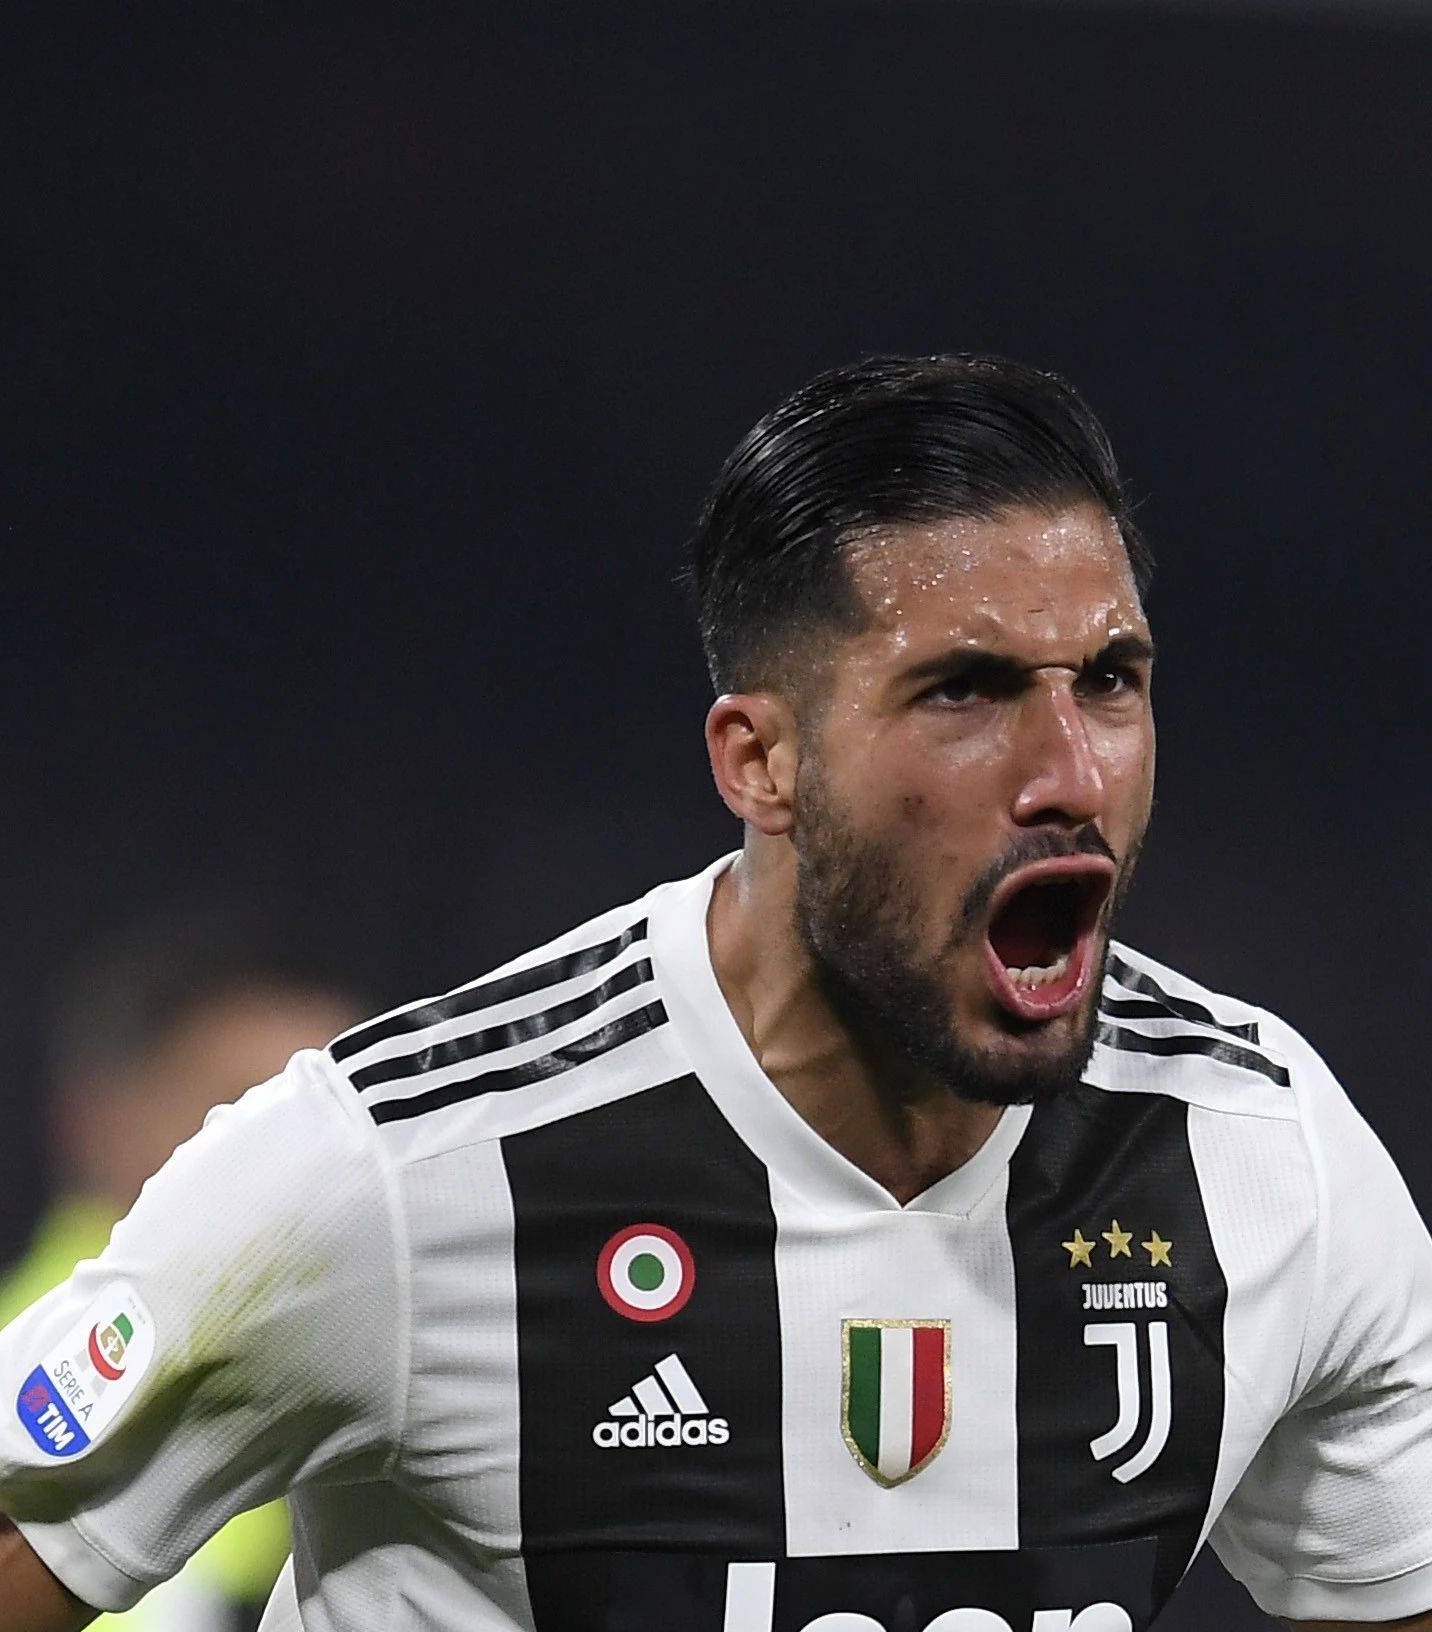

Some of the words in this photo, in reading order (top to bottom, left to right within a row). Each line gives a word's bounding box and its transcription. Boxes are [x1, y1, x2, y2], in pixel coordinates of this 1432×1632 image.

[1082, 1281, 1168, 1310] JUVENTUS
[54, 1361, 85, 1405] SERIE
[78, 1403, 94, 1422] A
[37, 1402, 75, 1451] TIM
[593, 1413, 730, 1448] adidas
